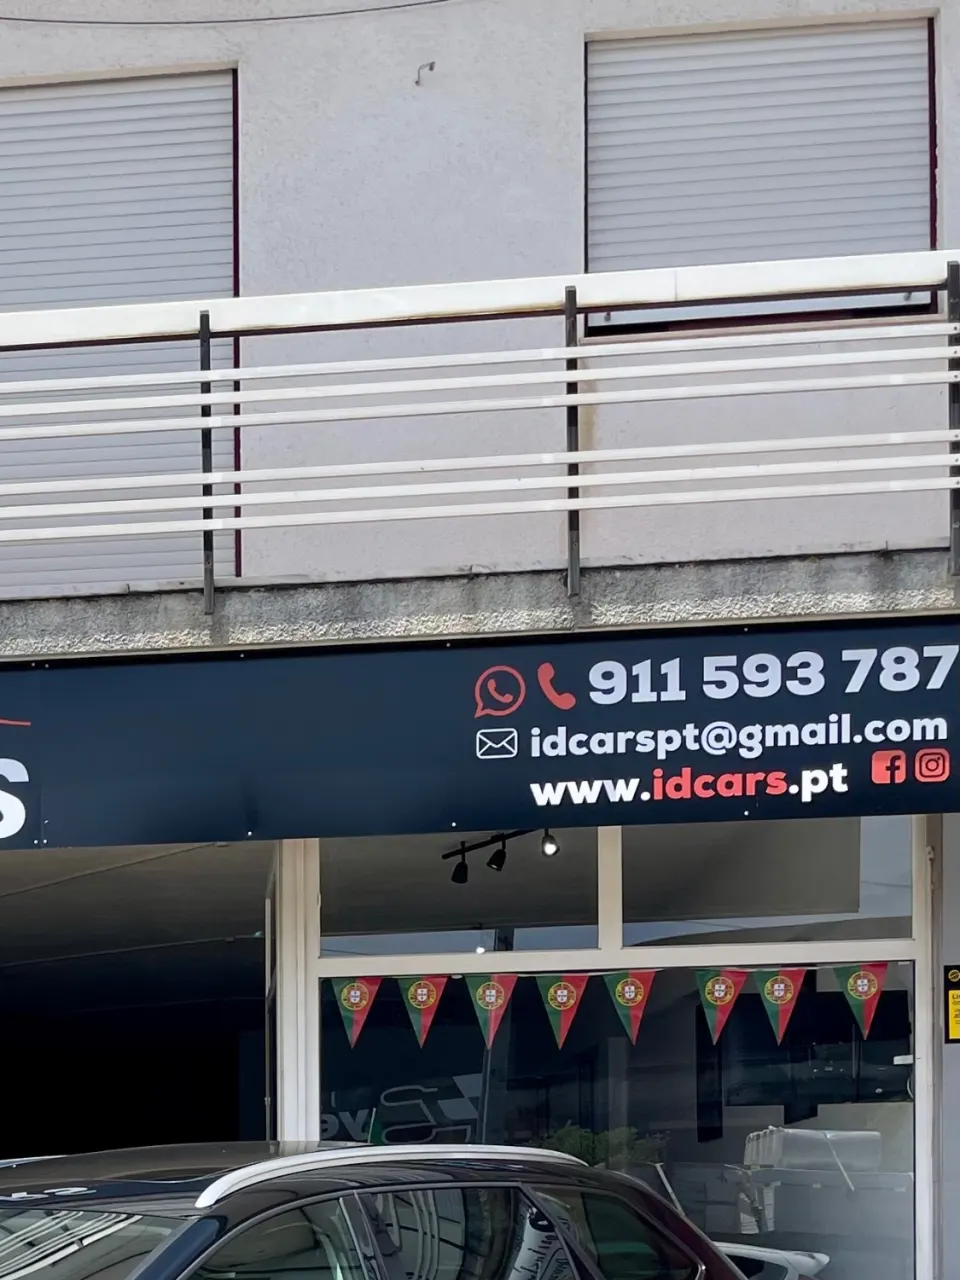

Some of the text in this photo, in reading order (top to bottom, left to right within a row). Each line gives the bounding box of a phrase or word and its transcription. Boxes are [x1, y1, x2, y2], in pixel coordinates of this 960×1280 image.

[588, 644, 960, 705] 911 593 787
[530, 713, 948, 761] idcarspt@gmail.com
[529, 762, 849, 807] www.idcars.pt
